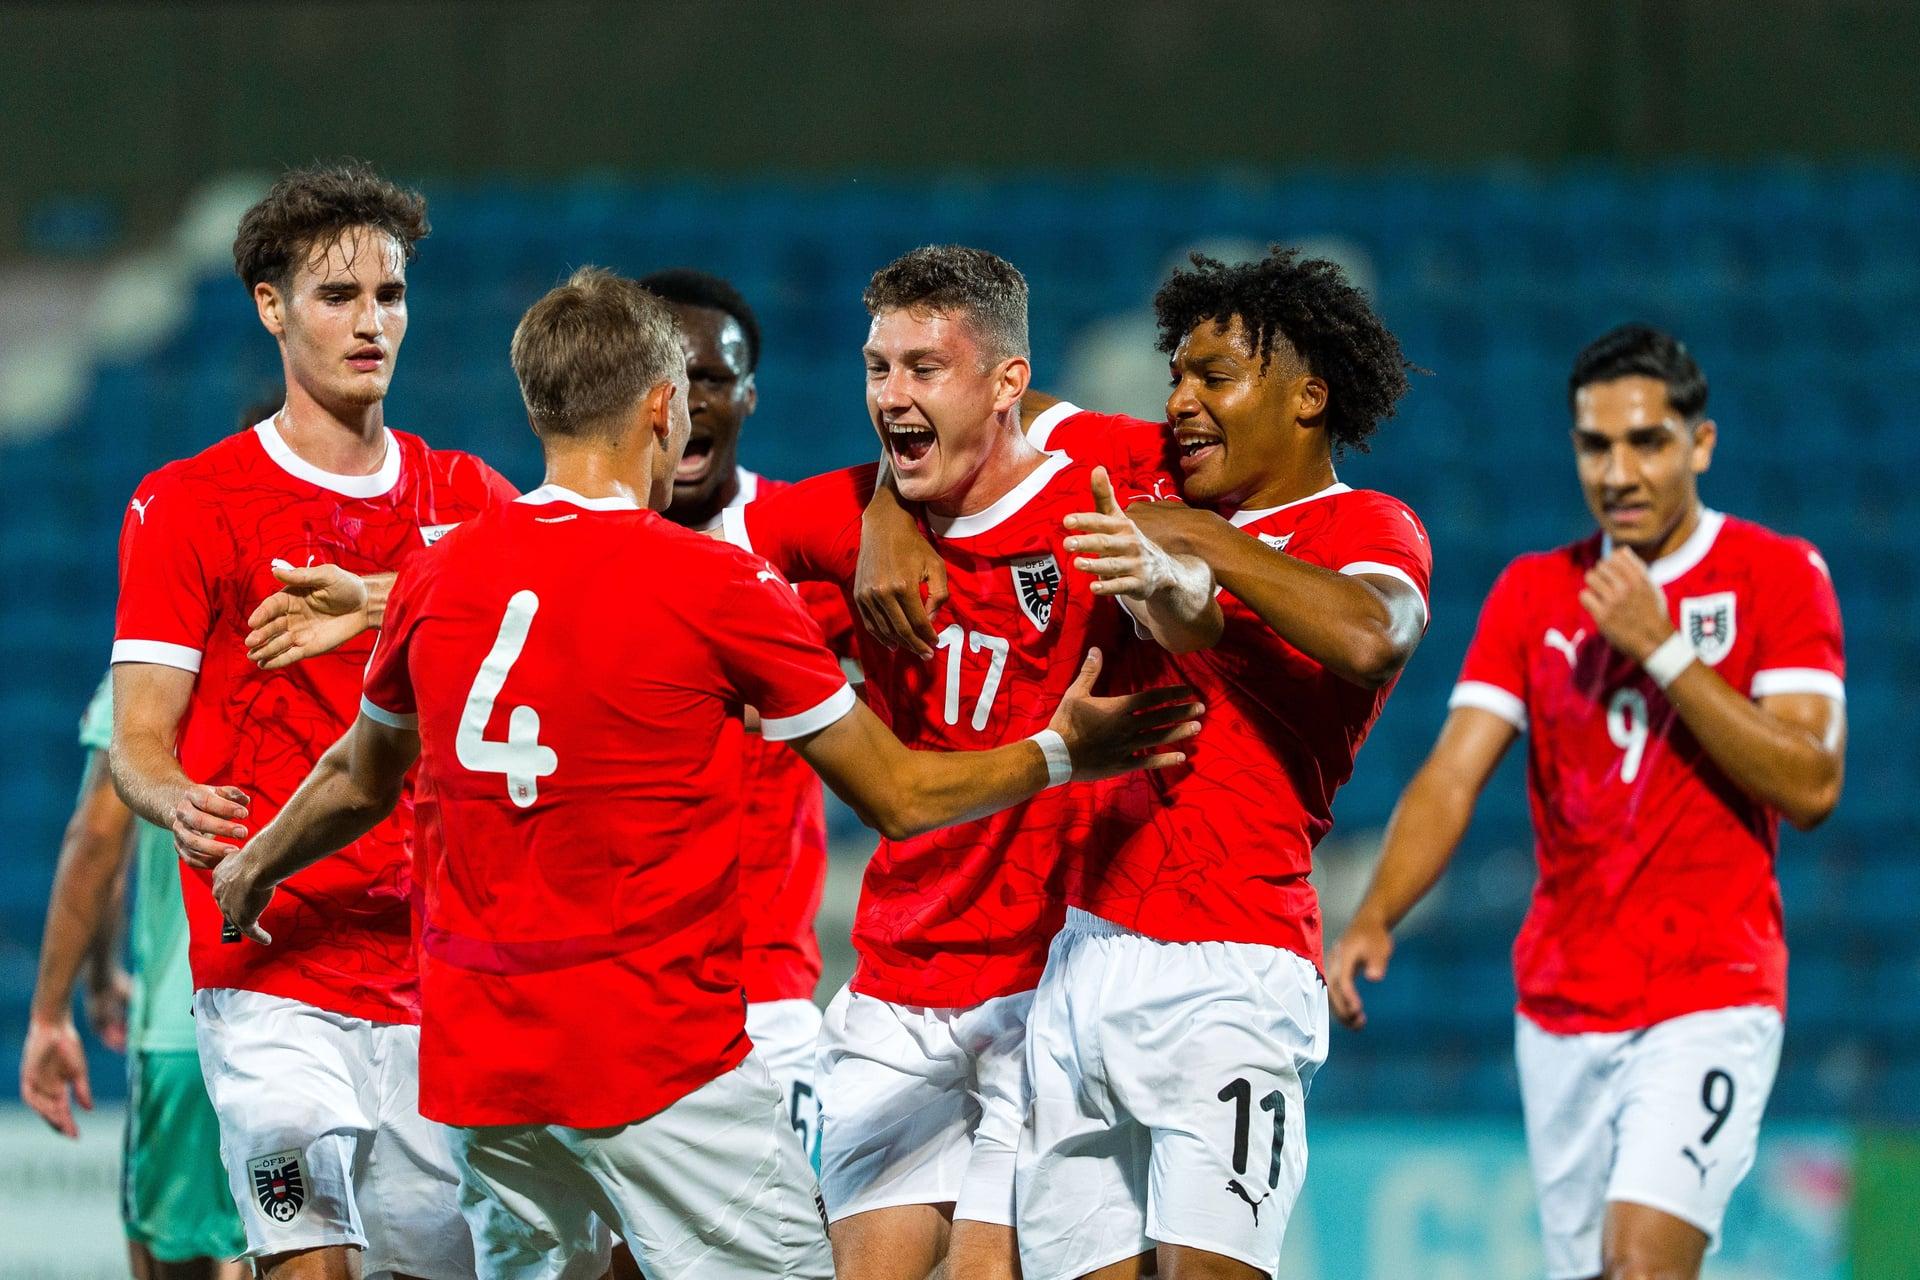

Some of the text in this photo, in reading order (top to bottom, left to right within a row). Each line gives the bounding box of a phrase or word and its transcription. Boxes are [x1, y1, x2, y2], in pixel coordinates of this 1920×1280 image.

[455, 589, 558, 808] 4
[936, 623, 1010, 731] 17
[1606, 688, 1650, 784] 9
[1217, 1077, 1286, 1190] 11
[1701, 1068, 1735, 1144] 9
